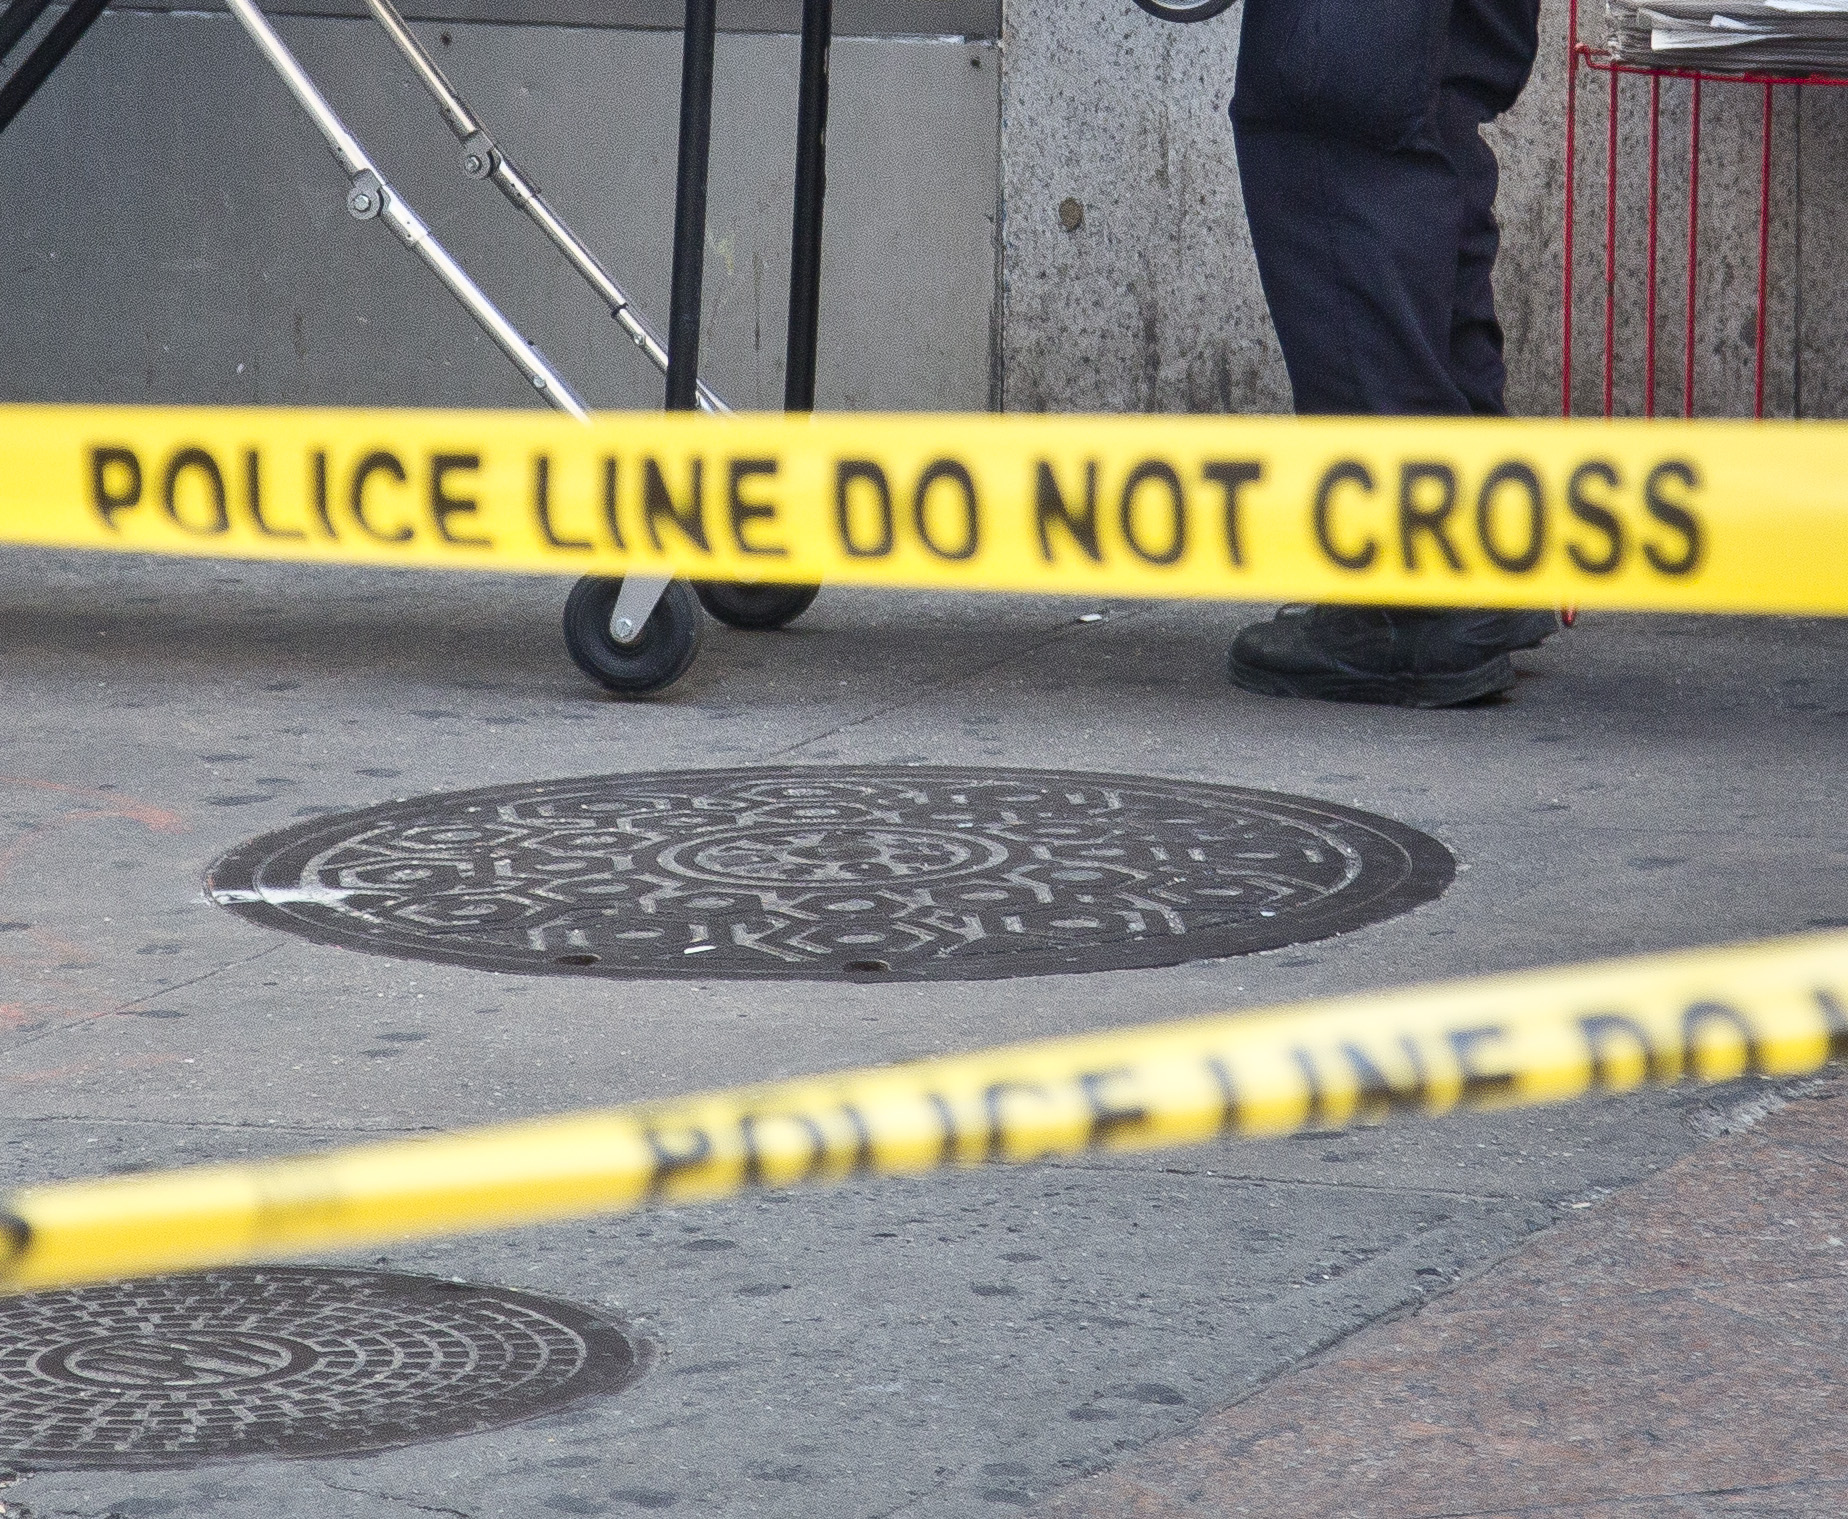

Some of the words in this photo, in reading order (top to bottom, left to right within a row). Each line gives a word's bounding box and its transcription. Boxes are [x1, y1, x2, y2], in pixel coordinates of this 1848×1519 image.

[88, 442, 494, 550] POLICE
[532, 449, 792, 558] LINE
[834, 454, 981, 566] DO
[1032, 455, 1268, 572] NOT
[1308, 455, 1709, 579] CROSS
